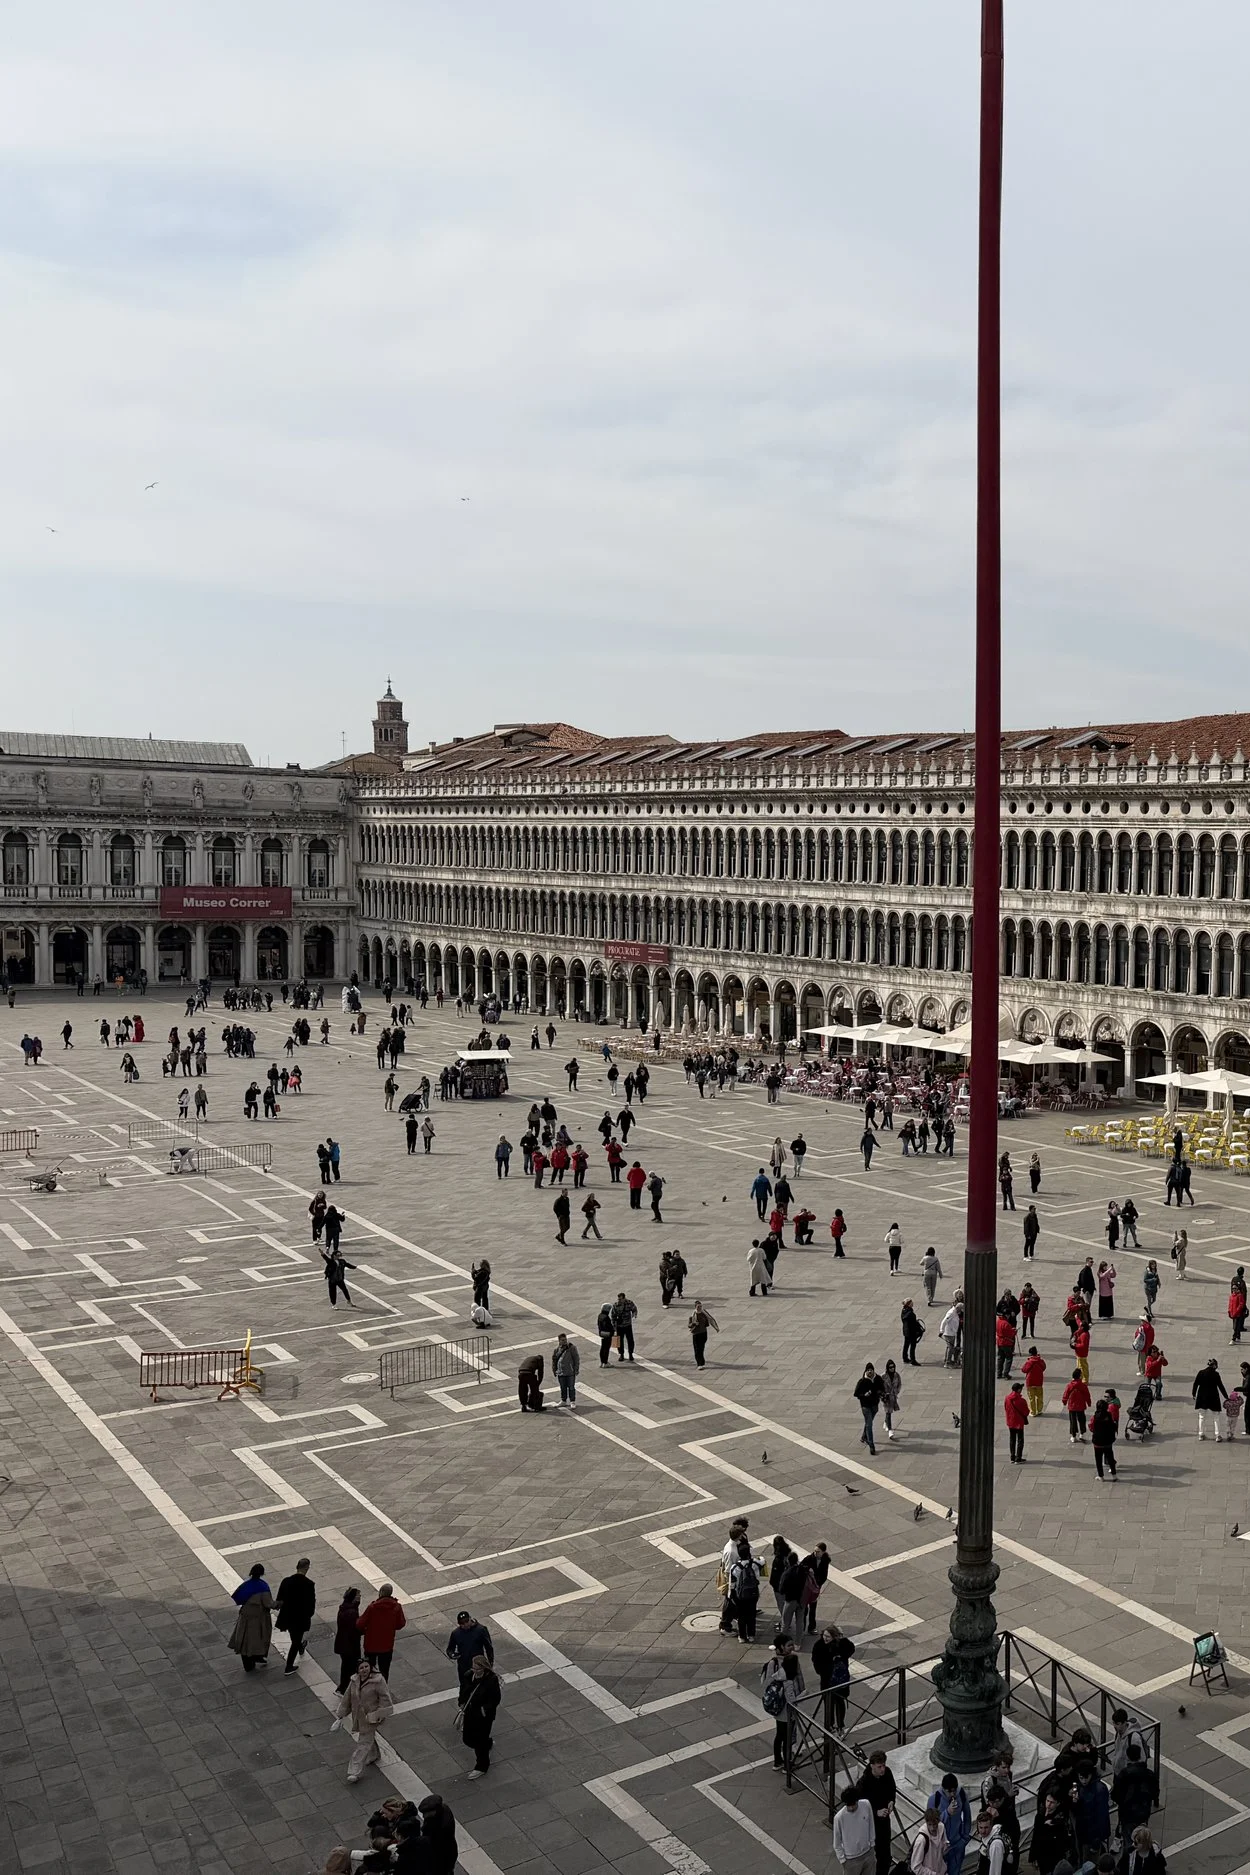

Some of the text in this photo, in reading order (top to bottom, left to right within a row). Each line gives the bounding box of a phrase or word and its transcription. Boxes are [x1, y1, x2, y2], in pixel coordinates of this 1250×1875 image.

[183, 897, 271, 908] Museo Correr
[608, 945, 641, 956] PROCURATIE
